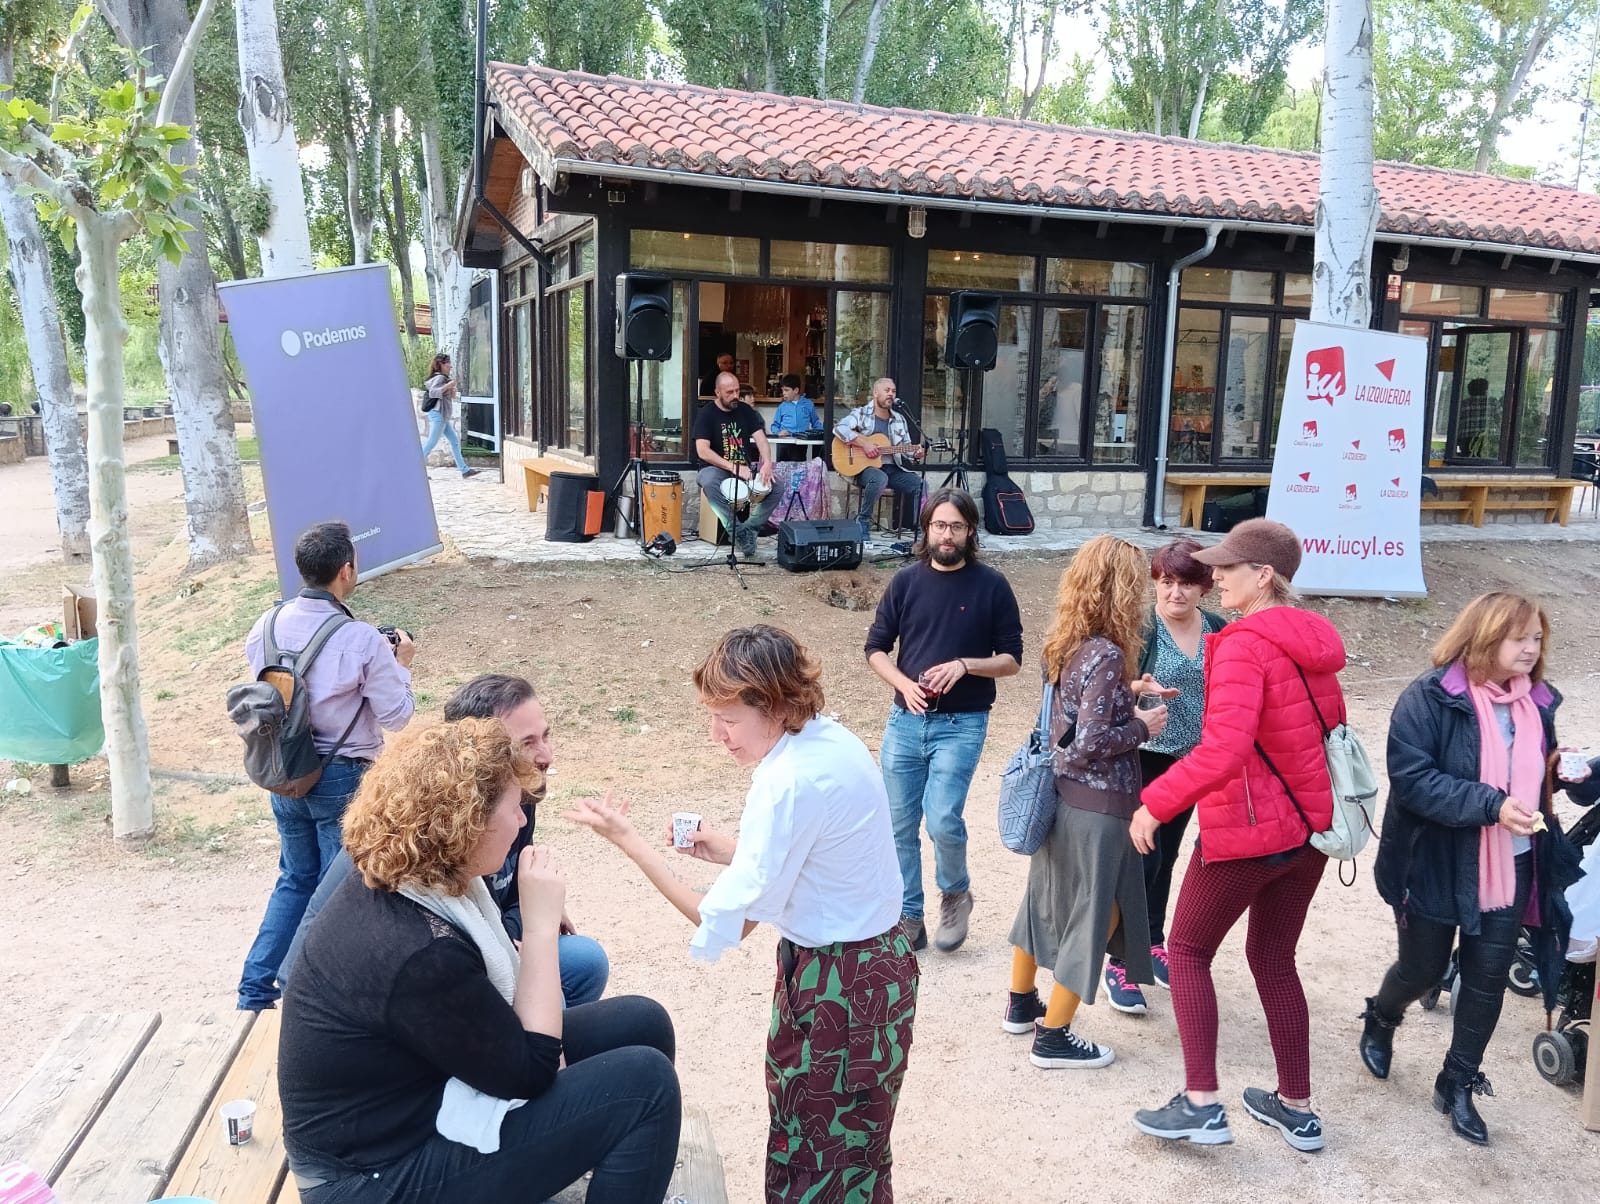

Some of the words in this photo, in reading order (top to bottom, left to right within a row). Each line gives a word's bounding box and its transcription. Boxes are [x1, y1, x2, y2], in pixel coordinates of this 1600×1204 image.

[303, 325, 366, 349] Podemos
[1354, 384, 1366, 401] LA
[1366, 385, 1411, 406] IZQUIERDA
[351, 526, 381, 543] demos.info
[1303, 534, 1404, 560] ww.iucyl.es
